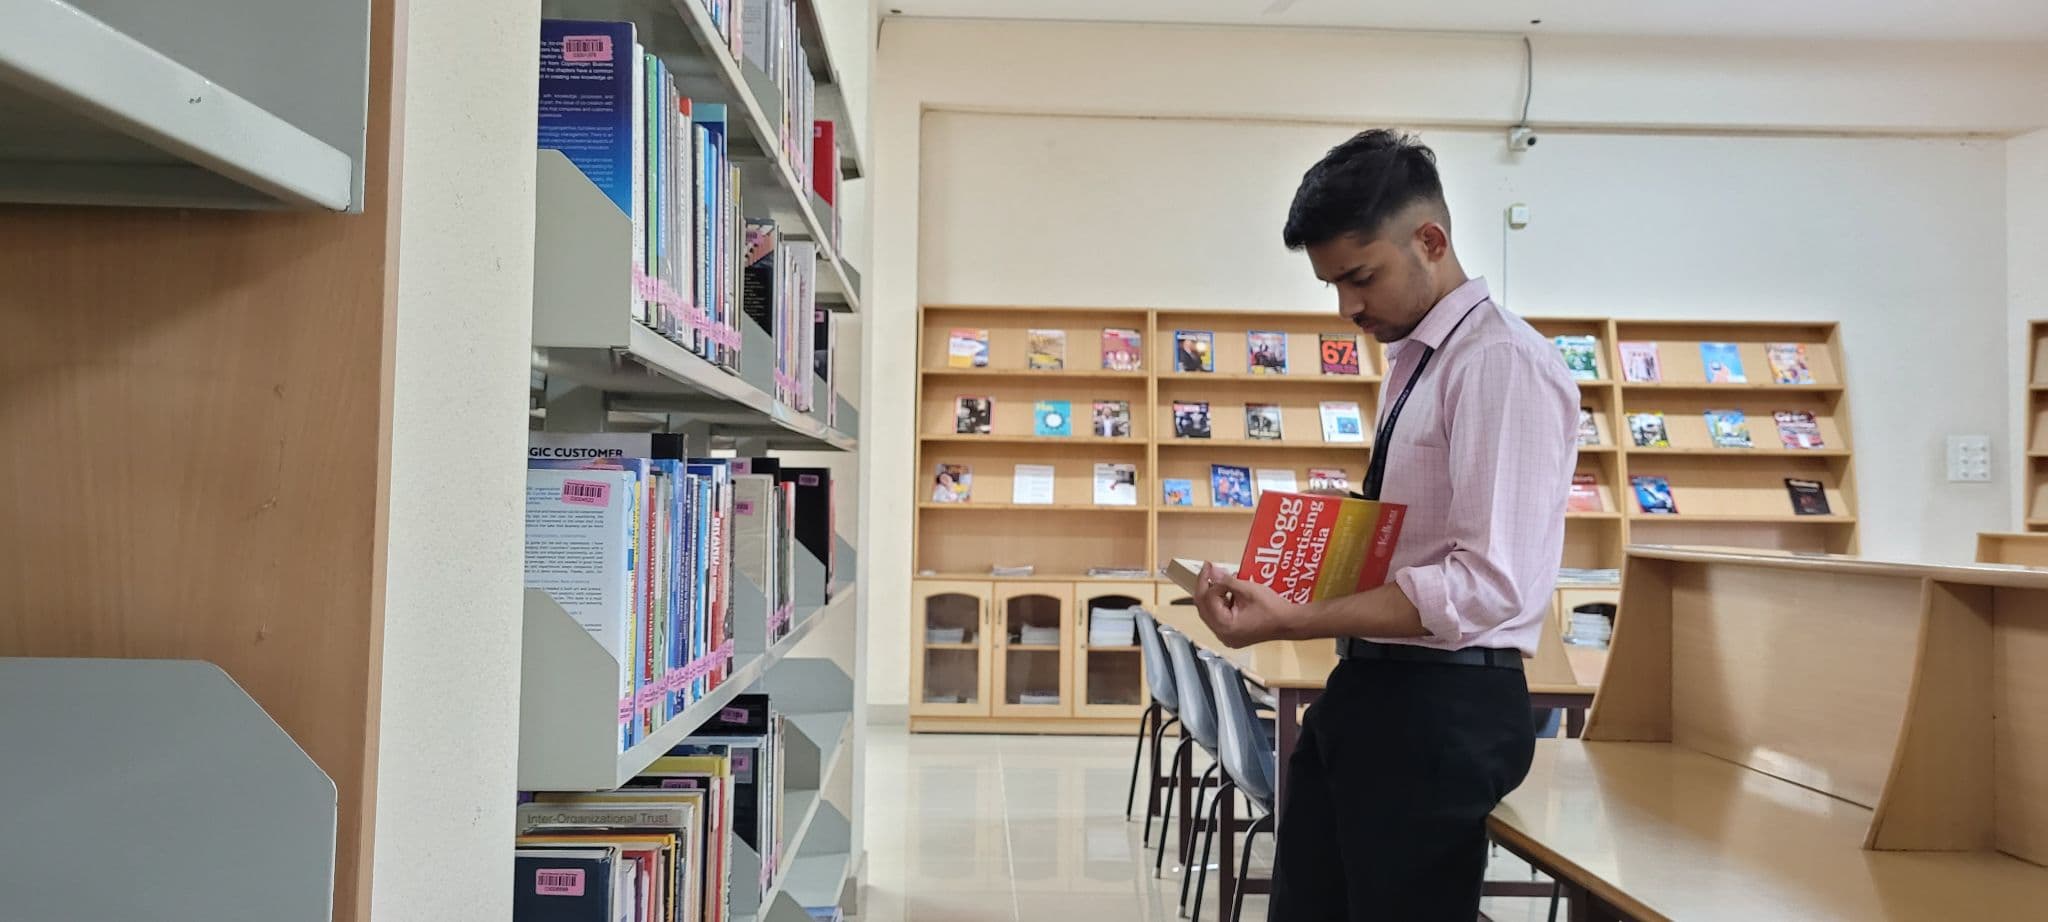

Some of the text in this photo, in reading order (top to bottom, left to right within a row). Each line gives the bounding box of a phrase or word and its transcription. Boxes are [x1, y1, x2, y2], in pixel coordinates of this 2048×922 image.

[554, 448, 623, 458] CUSTOMER
[1249, 497, 1303, 587] ellogg
[1280, 500, 1325, 601] Advertising
[1300, 528, 1330, 581] Media
[1281, 551, 1294, 569] on
[527, 812, 669, 825] Inter-Organizational Trust
